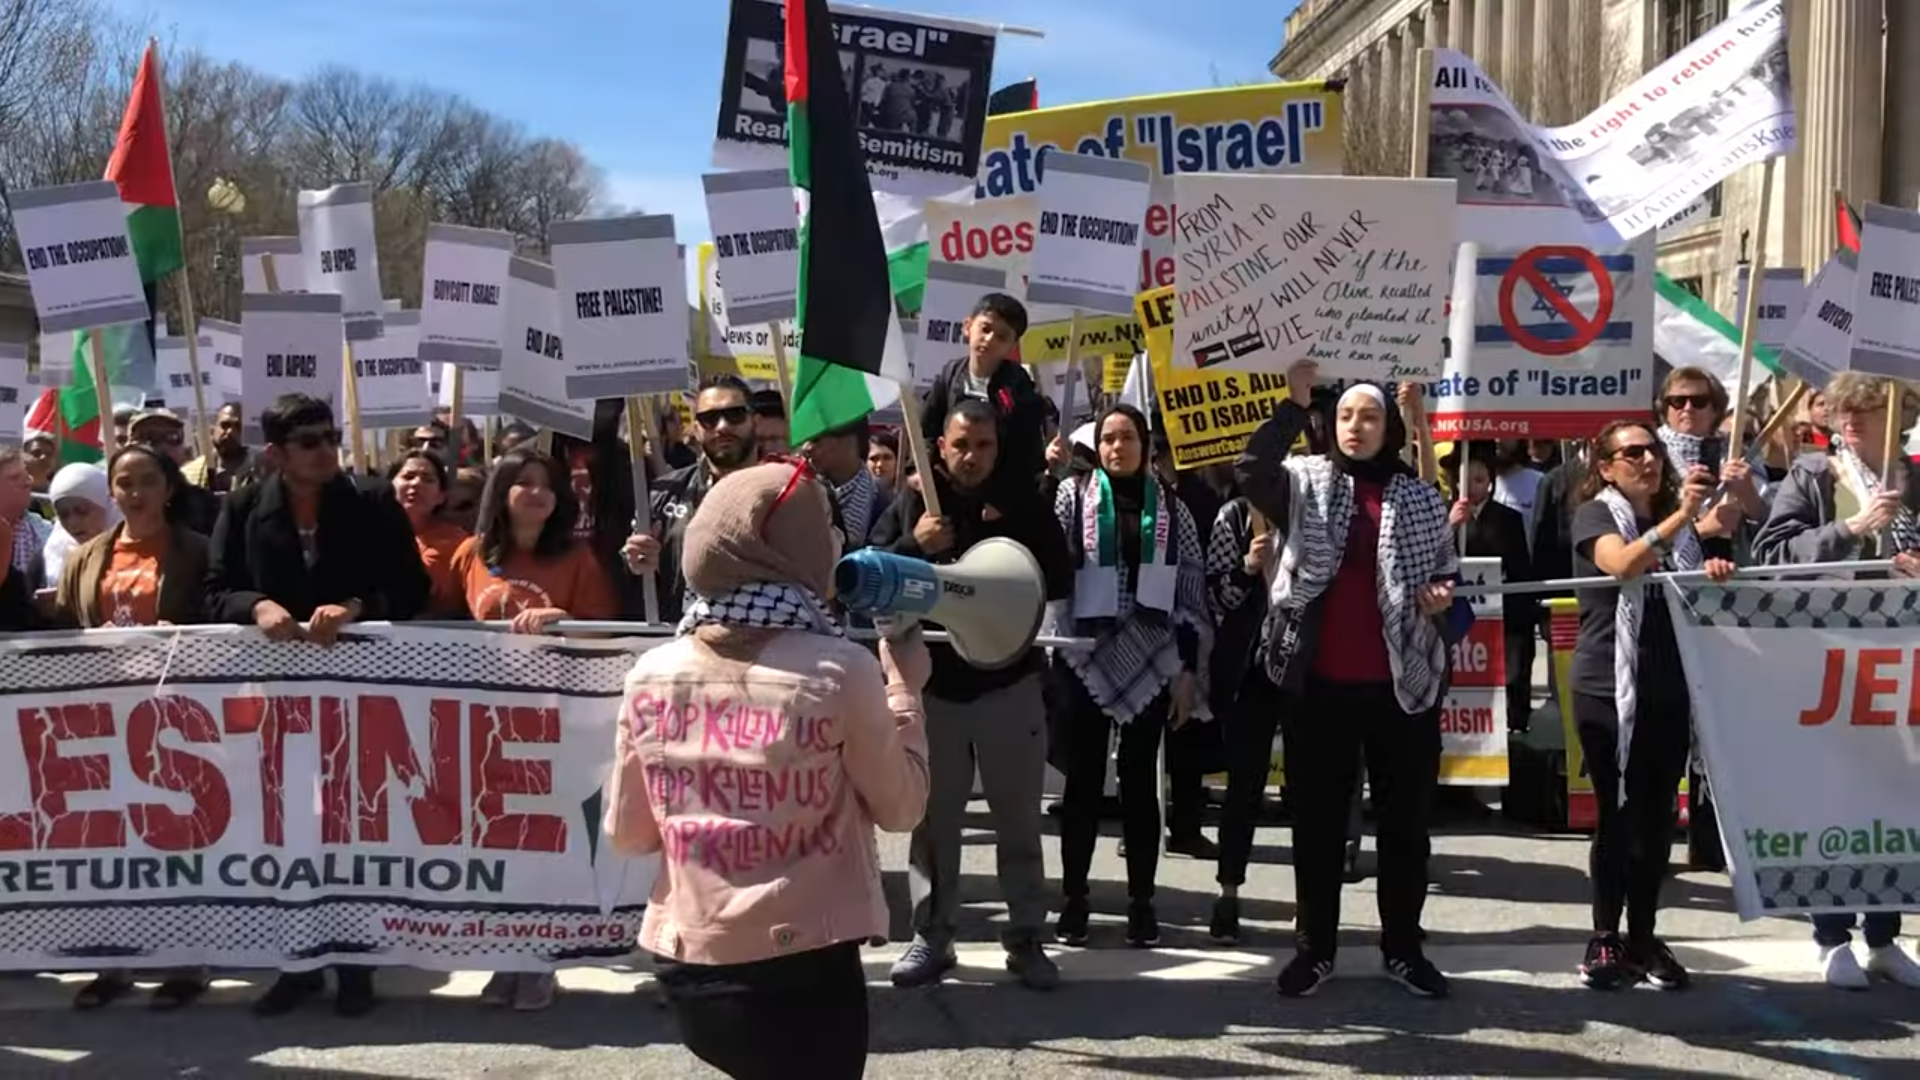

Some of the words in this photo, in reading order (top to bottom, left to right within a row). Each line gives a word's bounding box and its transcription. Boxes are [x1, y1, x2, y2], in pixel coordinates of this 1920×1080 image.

[1434, 66, 1467, 88] All
[1550, 137, 1586, 151] the
[1590, 101, 1642, 140] right
[1643, 85, 1668, 104] to
[1671, 38, 1737, 86] return
[1137, 102, 1321, 176] "Israel"
[1040, 210, 1059, 235] END
[1061, 213, 1078, 239] THE
[1079, 215, 1140, 247] OCCUPATION!
[1177, 193, 1234, 243] FROM
[1283, 211, 1326, 252] OUR
[27, 247, 48, 270] END
[47, 244, 68, 268] THE
[67, 235, 130, 264] OCCUPATION!
[717, 235, 734, 259] END
[733, 233, 751, 258] THE
[941, 220, 1034, 263] does
[1182, 222, 1254, 283] SYRIA
[1380, 248, 1428, 272] the
[434, 279, 471, 303] BOYCOTT
[471, 282, 500, 306] ISRAEL!
[1186, 297, 1264, 351] unity
[1270, 271, 1320, 310] WILL
[1313, 209, 1381, 276] NEVER
[1870, 271, 1894, 299] FREE
[576, 290, 603, 320] FREE
[602, 286, 664, 317] PALESTINE!
[1346, 306, 1409, 329] planted
[526, 326, 543, 354] END
[721, 325, 754, 345] Jews
[755, 331, 769, 347] or
[266, 353, 283, 377] END
[285, 353, 316, 378] AIPAC!
[1487, 369, 1520, 397] of
[1527, 368, 1642, 397] "Israel"
[1163, 383, 1209, 413] END
[1210, 376, 1246, 401] U.S.
[1179, 410, 1209, 435] TO
[631, 691, 699, 742] STOP
[0, 693, 568, 854] ESTINE
[219, 851, 507, 893] COALITION
[383, 913, 625, 942] www.al-awda.org
